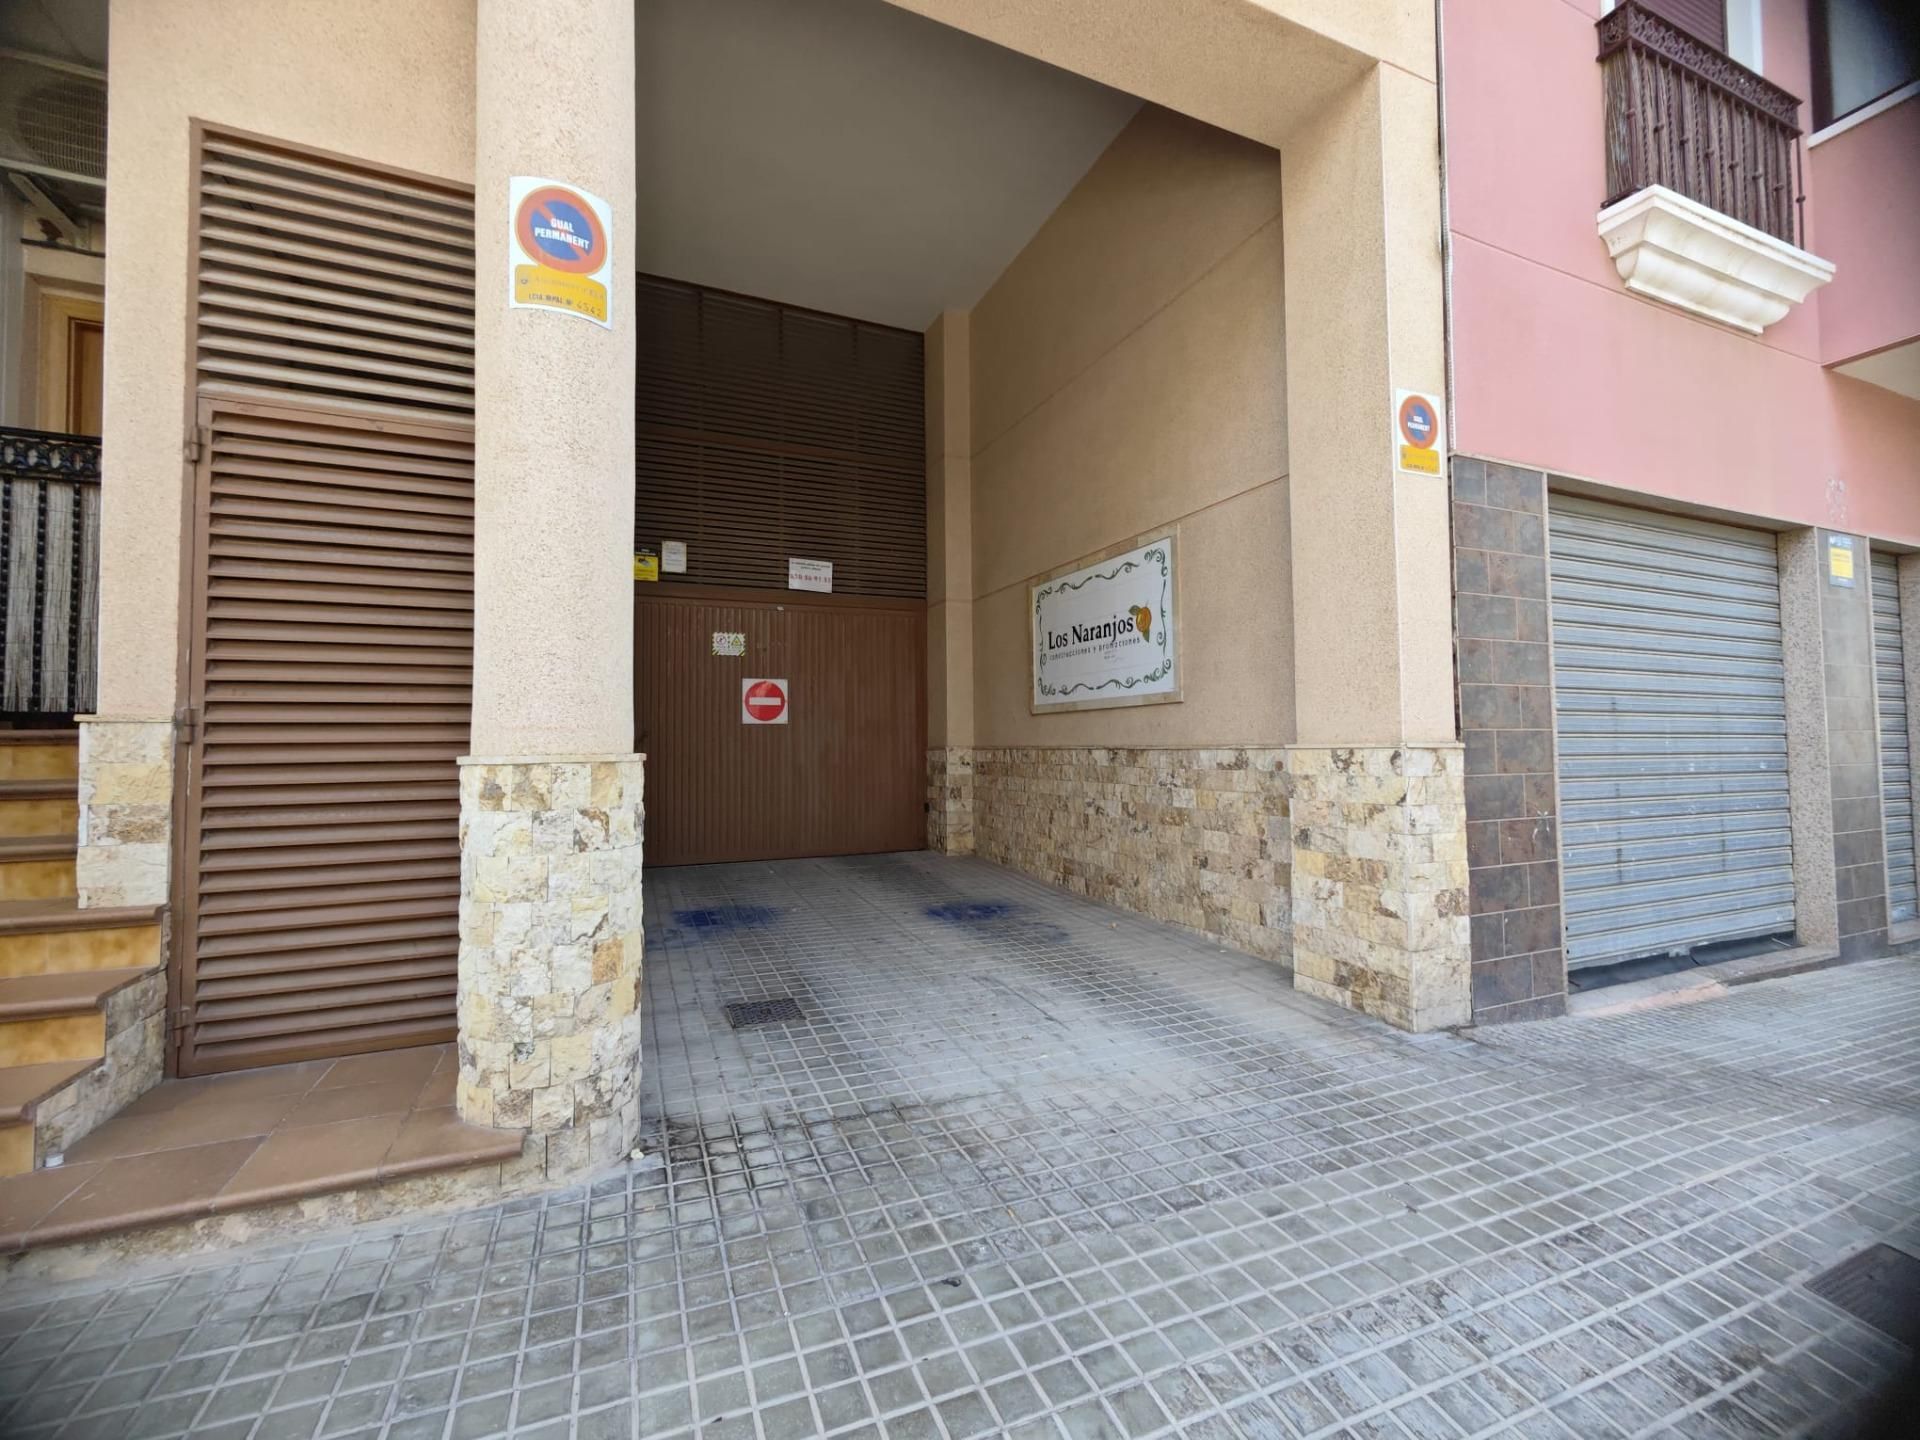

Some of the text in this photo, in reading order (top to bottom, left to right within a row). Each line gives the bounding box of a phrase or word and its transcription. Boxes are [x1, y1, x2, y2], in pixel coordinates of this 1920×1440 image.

[550, 217, 574, 233] GUAL
[534, 227, 590, 250] PERMANENT
[1048, 615, 1134, 650] Los Naranjos
[1049, 647, 1091, 661] construcciones
